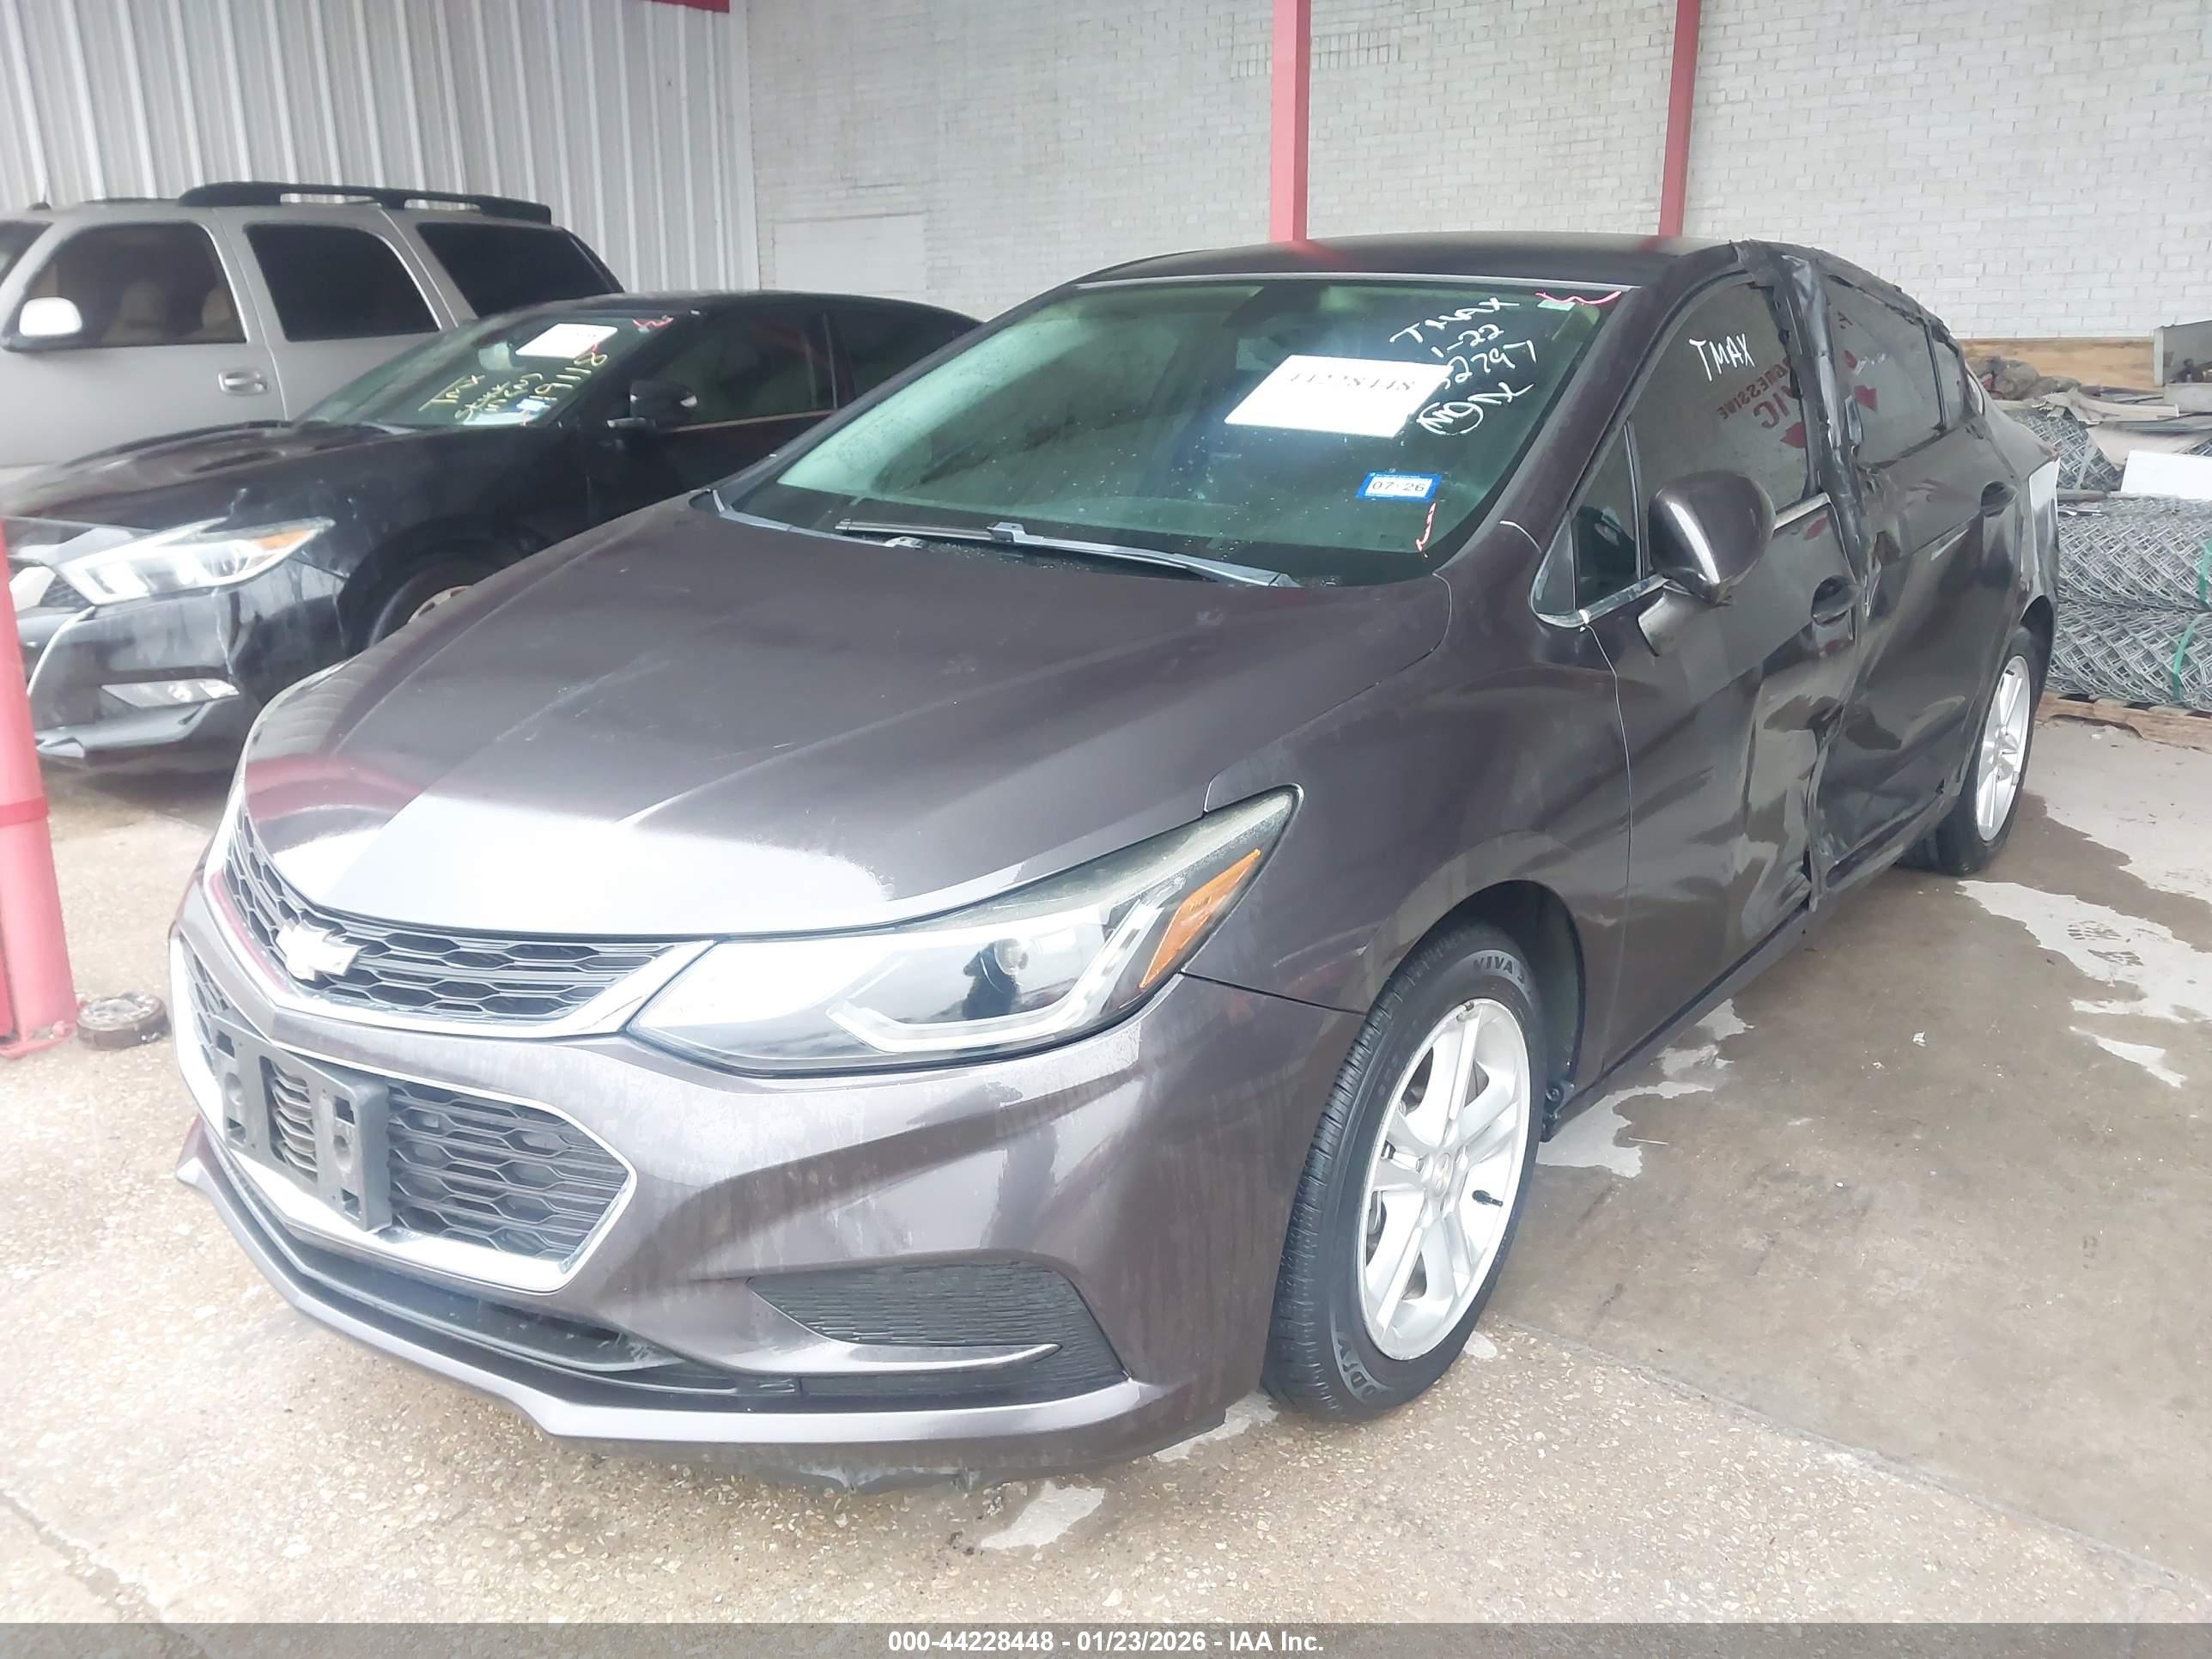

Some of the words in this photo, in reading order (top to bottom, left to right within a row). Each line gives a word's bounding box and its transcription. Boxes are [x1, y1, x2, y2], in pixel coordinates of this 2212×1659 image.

[1431, 324, 1504, 358] 1-22
[1443, 339, 1537, 391] 2797
[1689, 333, 1755, 381] TMAX
